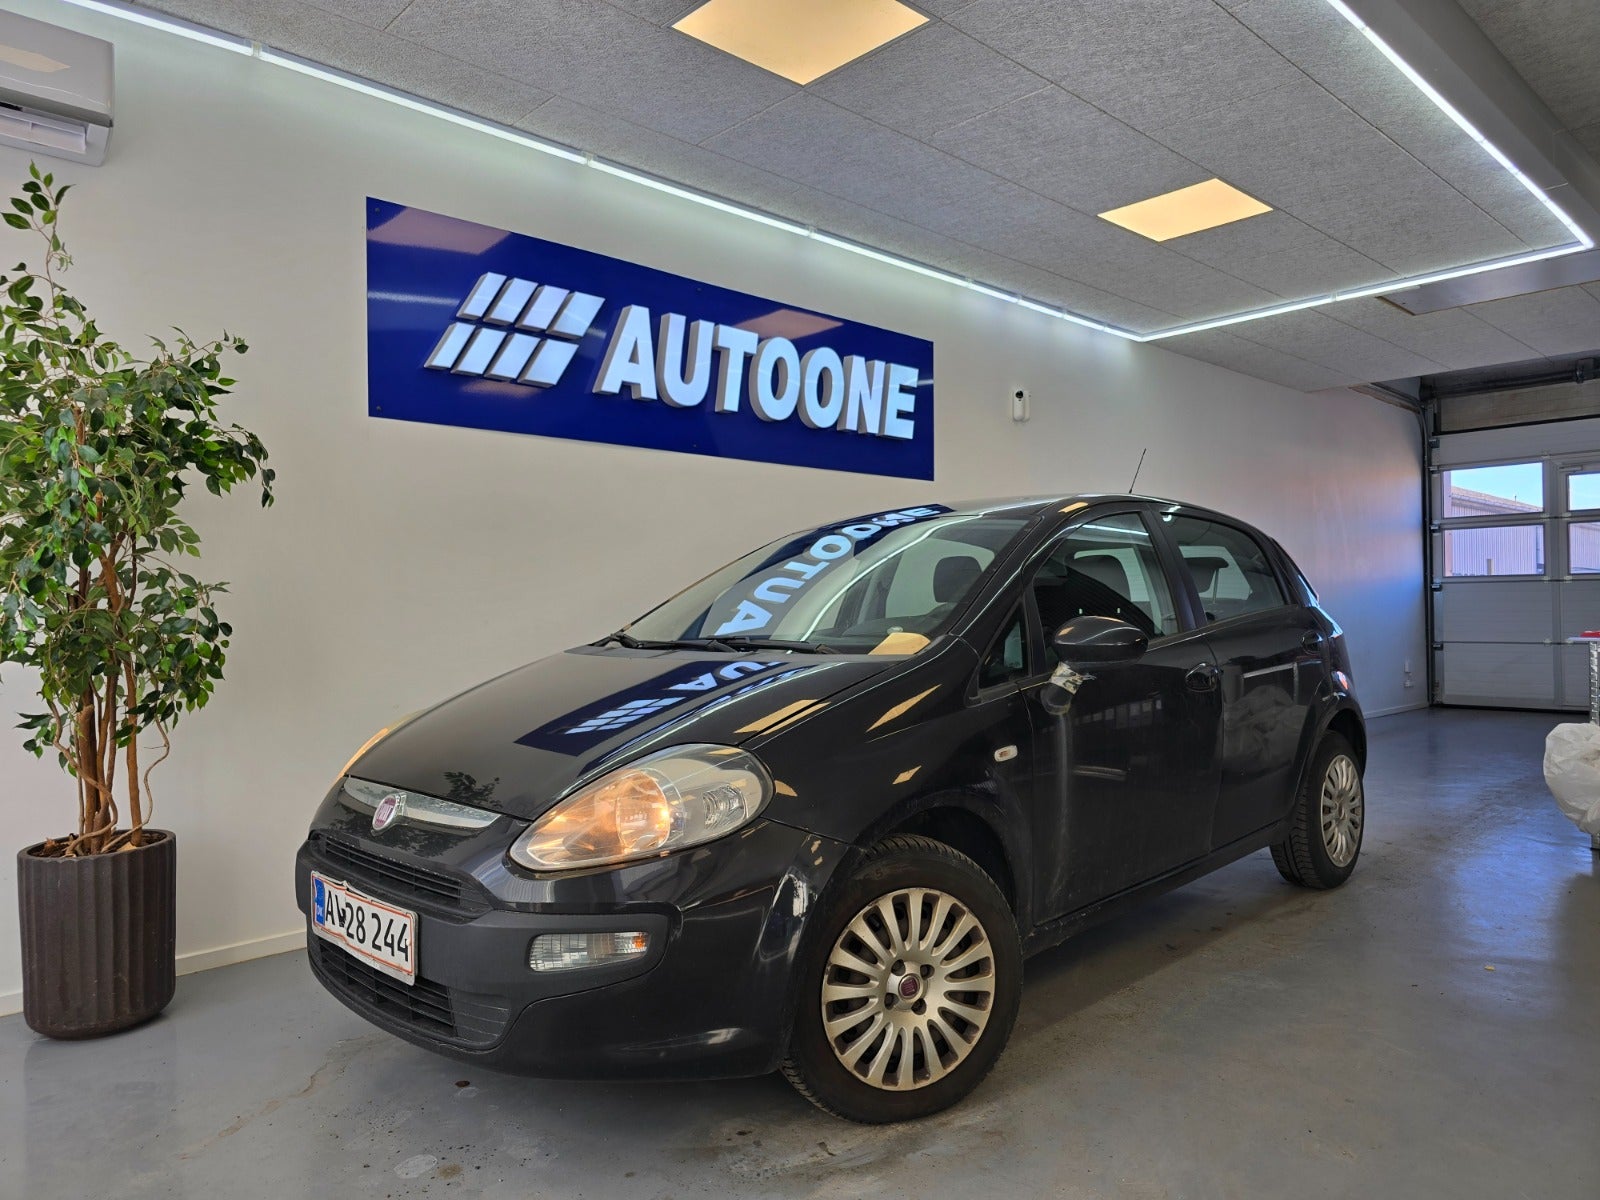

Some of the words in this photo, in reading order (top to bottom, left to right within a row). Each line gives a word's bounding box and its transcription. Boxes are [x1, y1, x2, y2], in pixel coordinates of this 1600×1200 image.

[593, 304, 919, 439] AUTOONE
[346, 903, 366, 944] 28
[372, 913, 409, 962] 244
